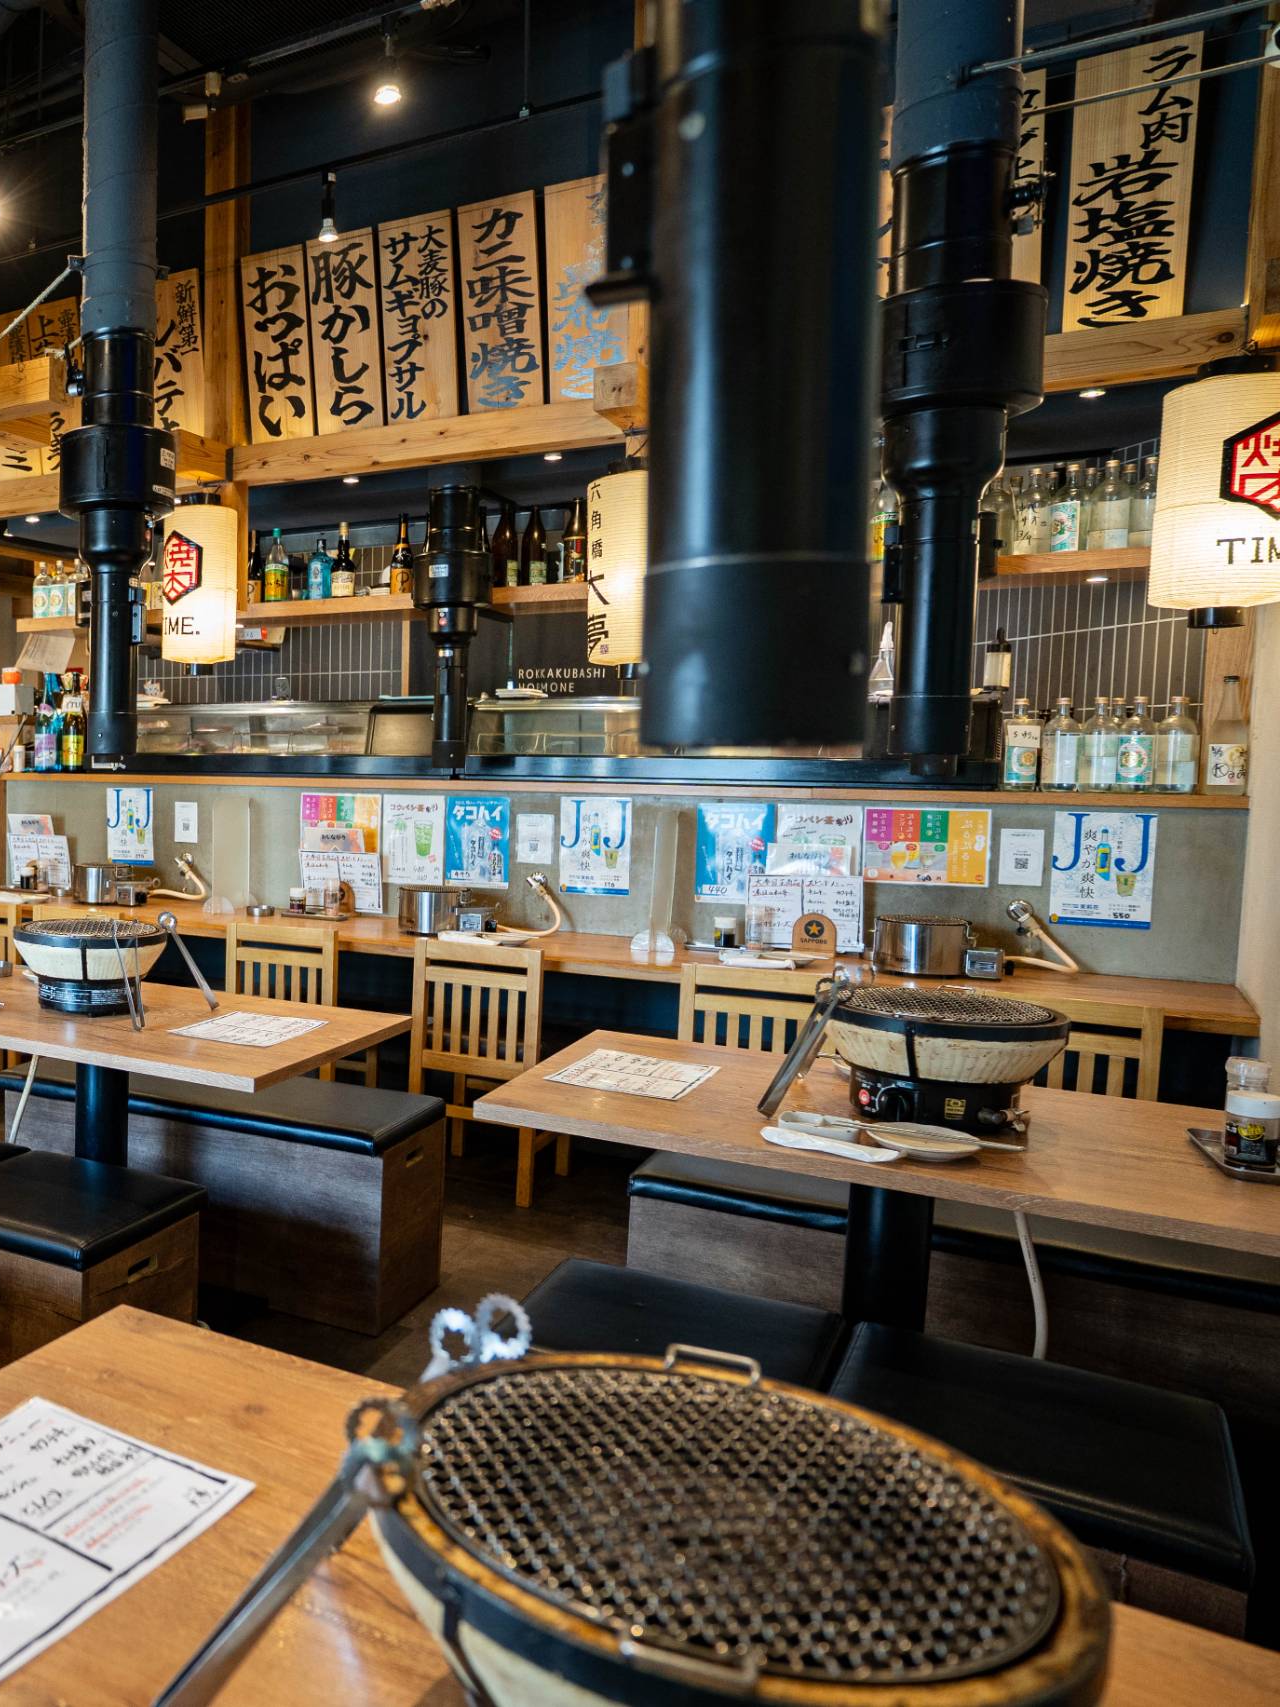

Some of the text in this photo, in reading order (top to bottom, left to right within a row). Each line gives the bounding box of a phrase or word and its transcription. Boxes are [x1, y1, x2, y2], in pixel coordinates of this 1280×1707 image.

[1138, 45, 1196, 150] ラム肉
[417, 225, 448, 320] 大麦豚の
[1070, 149, 1179, 329] 岩塩焼き
[175, 280, 199, 356] 新鮮第一
[311, 242, 375, 425] 豚かしら
[385, 232, 426, 421] サムギョプサル
[466, 207, 539, 408] カニ味噌焼き
[247, 263, 306, 437] おっぱい
[590, 482, 603, 559] 六角橋
[518, 668, 606, 680] ROKKAKUBASHI
[453, 805, 503, 821] タコハイ
[560, 800, 586, 848] J
[603, 800, 632, 849] J
[706, 812, 763, 830] タコハイ
[1052, 813, 1090, 872] J
[1114, 814, 1157, 873] J
[1079, 828, 1098, 899] 爽やか爽快
